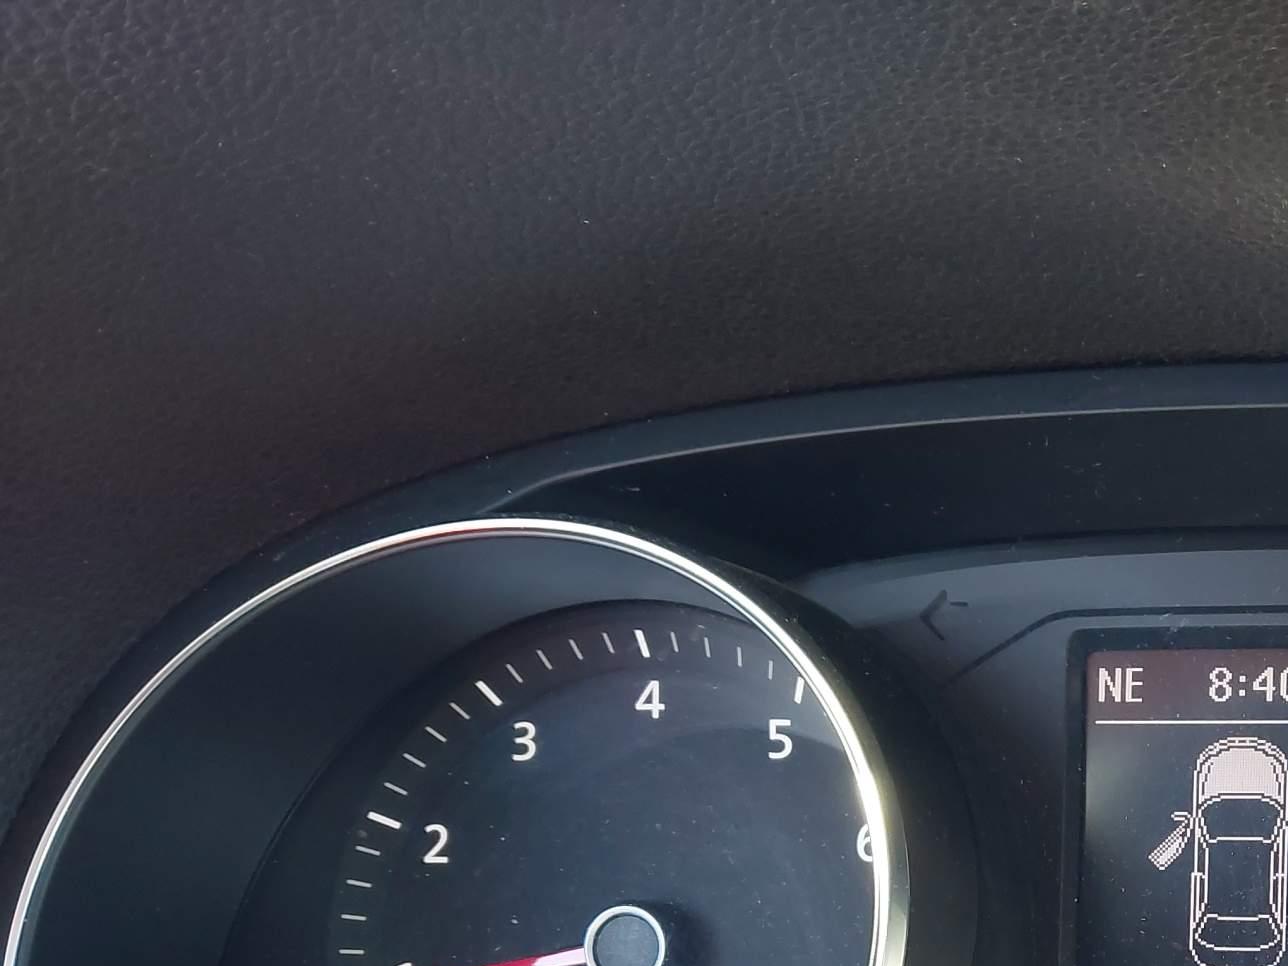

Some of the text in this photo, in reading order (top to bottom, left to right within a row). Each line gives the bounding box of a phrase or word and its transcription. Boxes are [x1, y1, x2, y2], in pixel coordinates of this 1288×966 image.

[635, 680, 666, 719] 4
[1097, 667, 1144, 703] NE
[512, 722, 537, 761] 3
[768, 720, 792, 759] 5
[424, 825, 449, 864] 2
